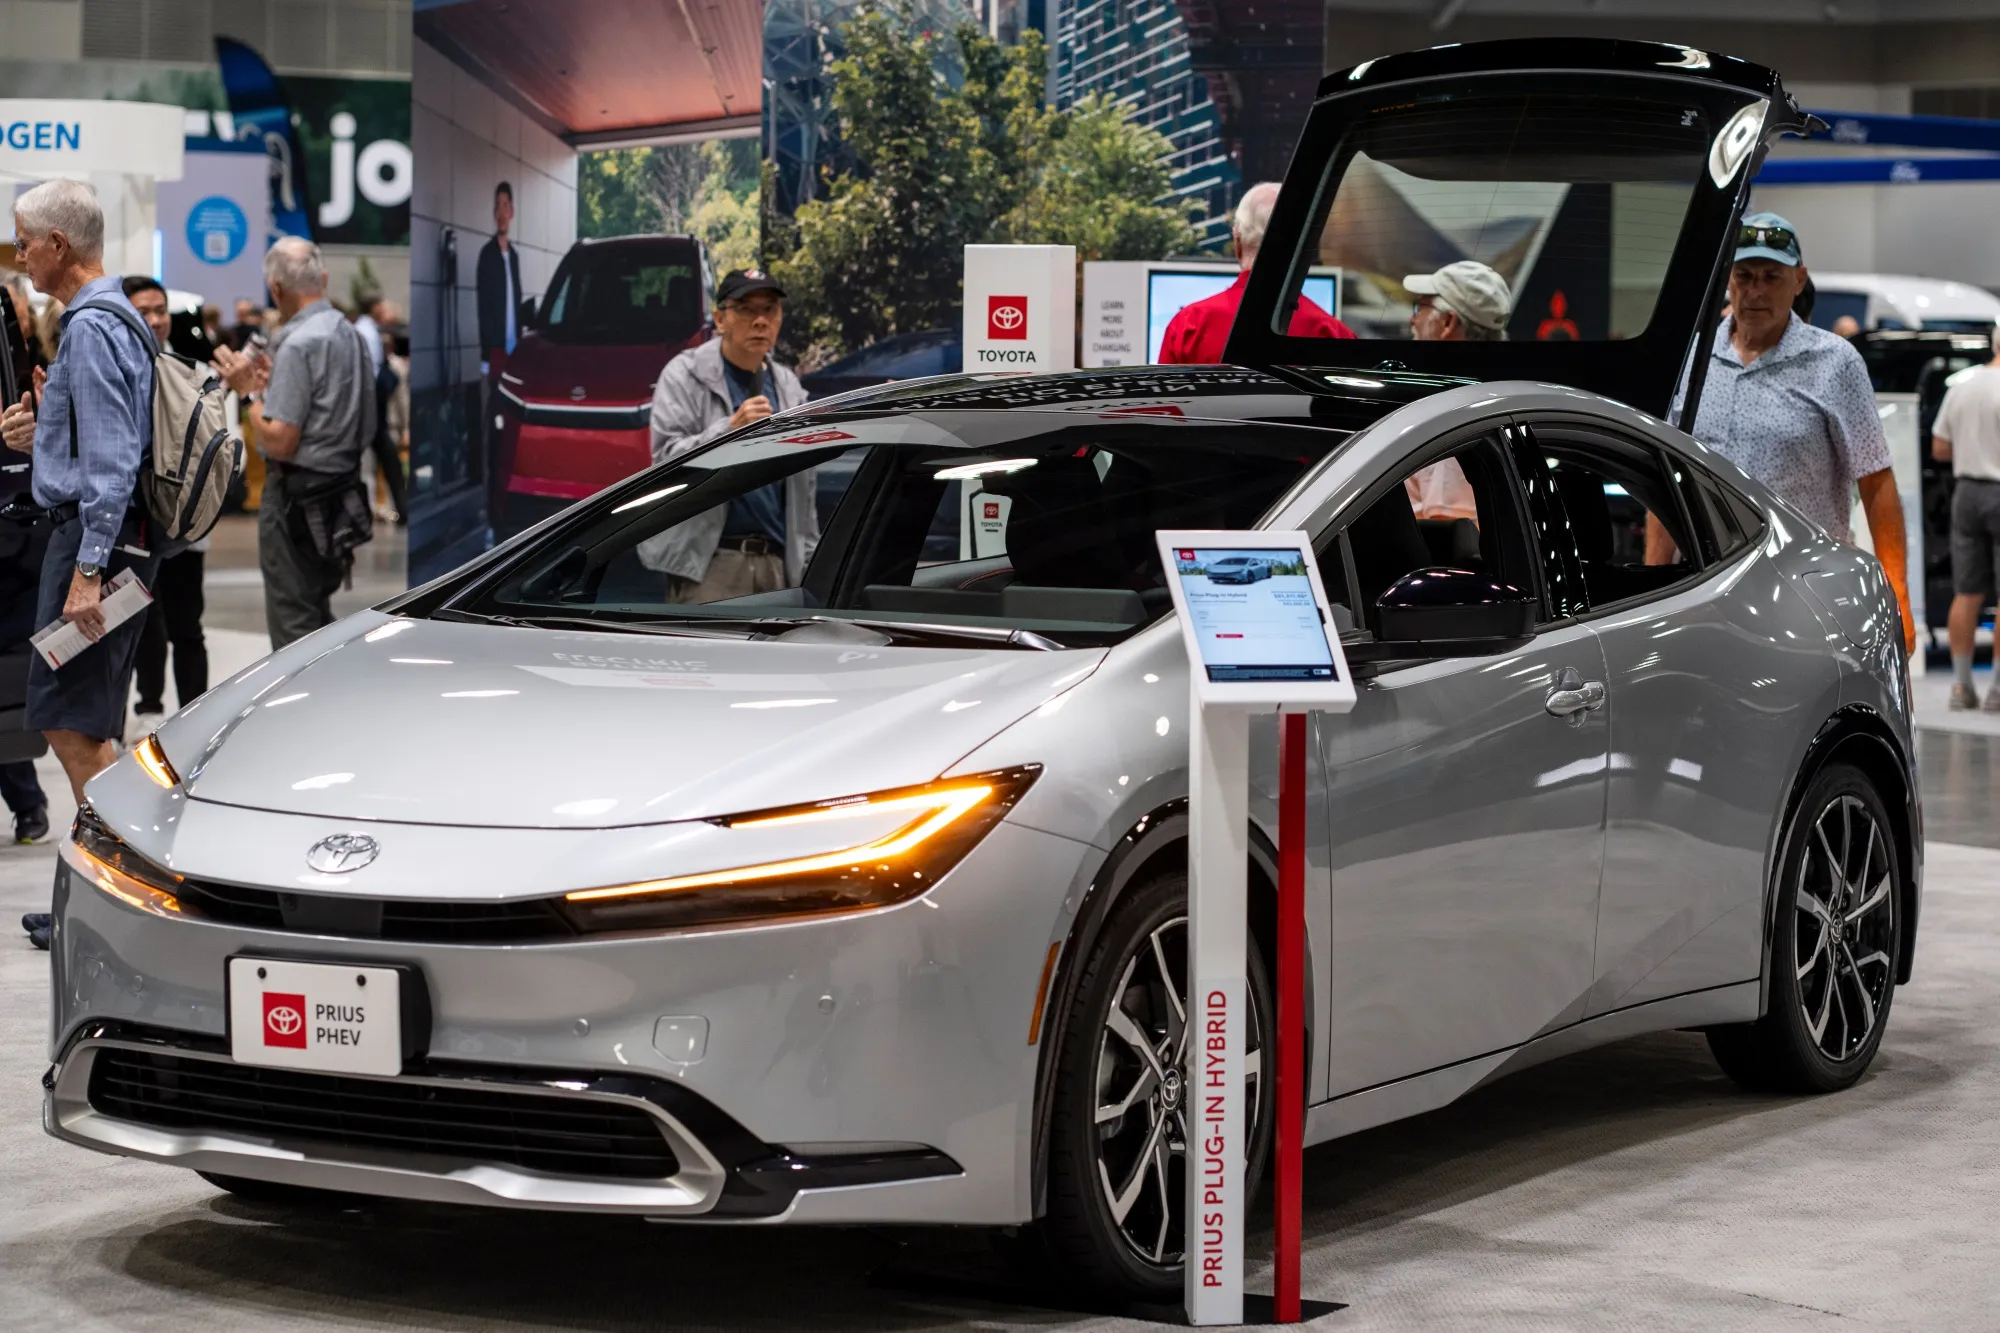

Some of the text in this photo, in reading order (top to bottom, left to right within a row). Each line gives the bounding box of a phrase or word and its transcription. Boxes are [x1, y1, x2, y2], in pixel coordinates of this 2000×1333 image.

[0, 121, 80, 150] GEN
[319, 111, 413, 228] jo
[978, 350, 1036, 363] TOYOTA
[315, 1003, 365, 1024] PRIUS
[316, 1027, 361, 1046] PHEV
[1203, 990, 1228, 1288] PRIUS PLUG-IN HYBRID
